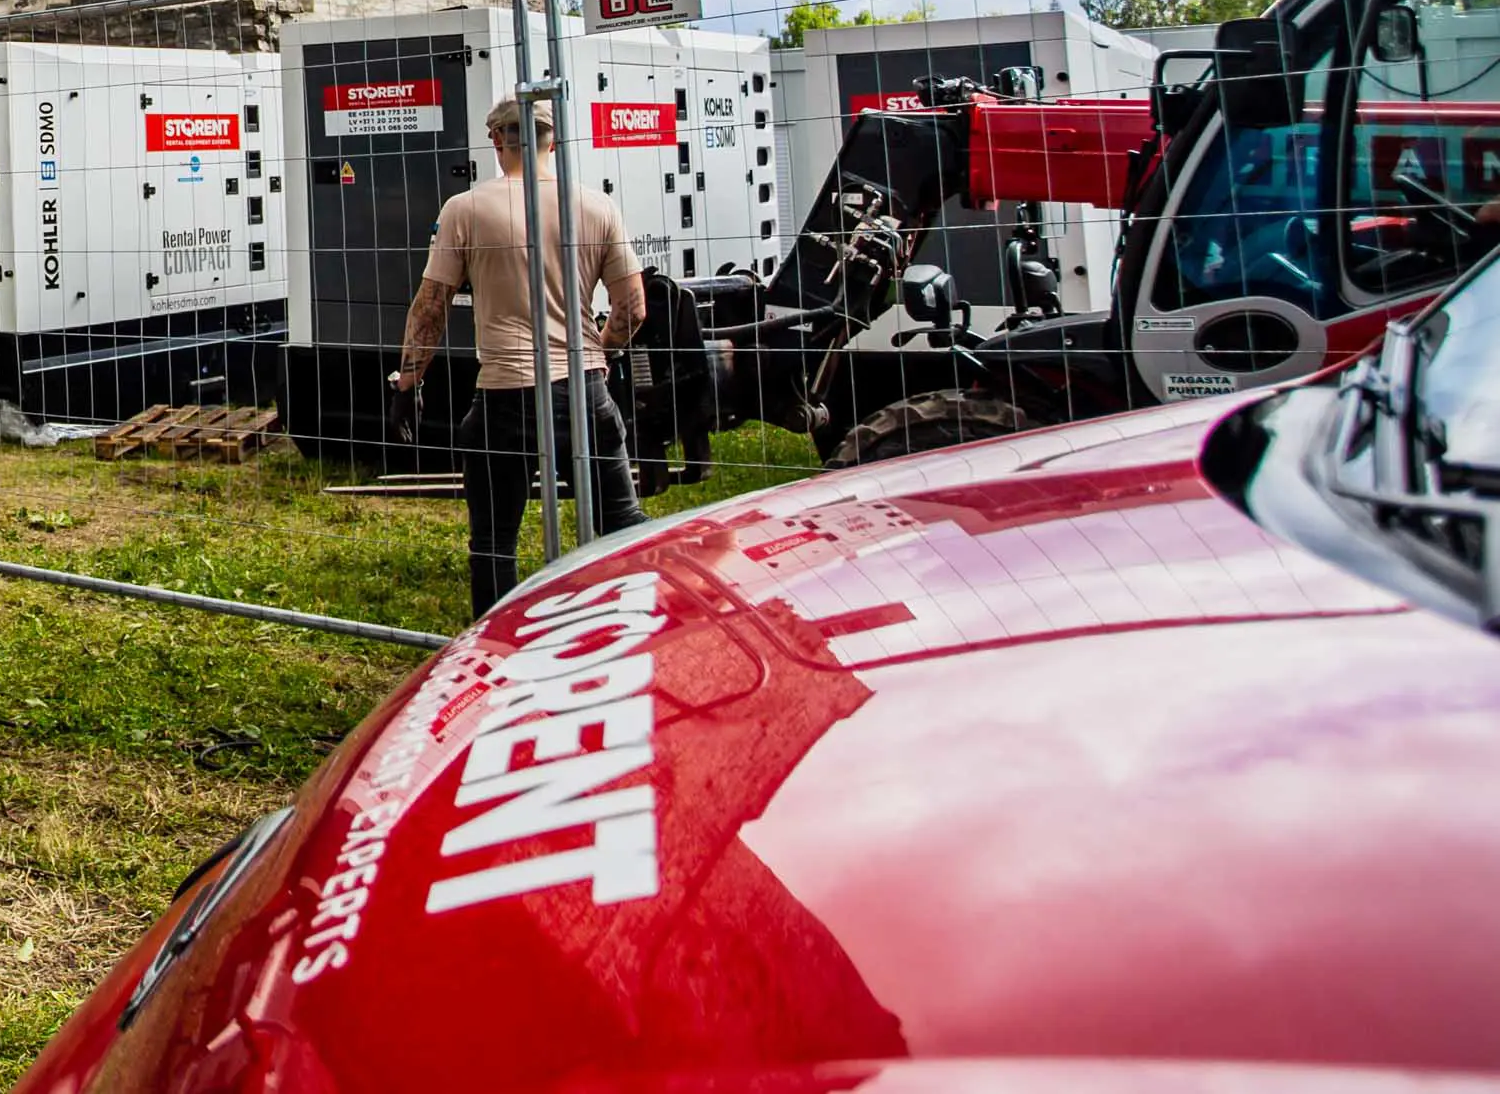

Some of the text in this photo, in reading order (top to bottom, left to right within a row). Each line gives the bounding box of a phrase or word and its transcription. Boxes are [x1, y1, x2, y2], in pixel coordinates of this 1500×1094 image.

[347, 84, 415, 100] STORENT
[704, 97, 733, 116] KOHLER
[165, 118, 231, 137] STORENT
[610, 108, 660, 131] STORENT
[716, 125, 736, 148] SDMO
[39, 101, 60, 290] KOHLER SDMO
[162, 228, 231, 248] Rental Power
[163, 245, 231, 276] COMPACT
[151, 296, 217, 311] kohlersdmo.com
[1169, 376, 1231, 384] TAGASTA
[1167, 386, 1235, 395] PUHTANA!
[426, 571, 669, 914] STORENT
[292, 799, 401, 986] EXPERTS
